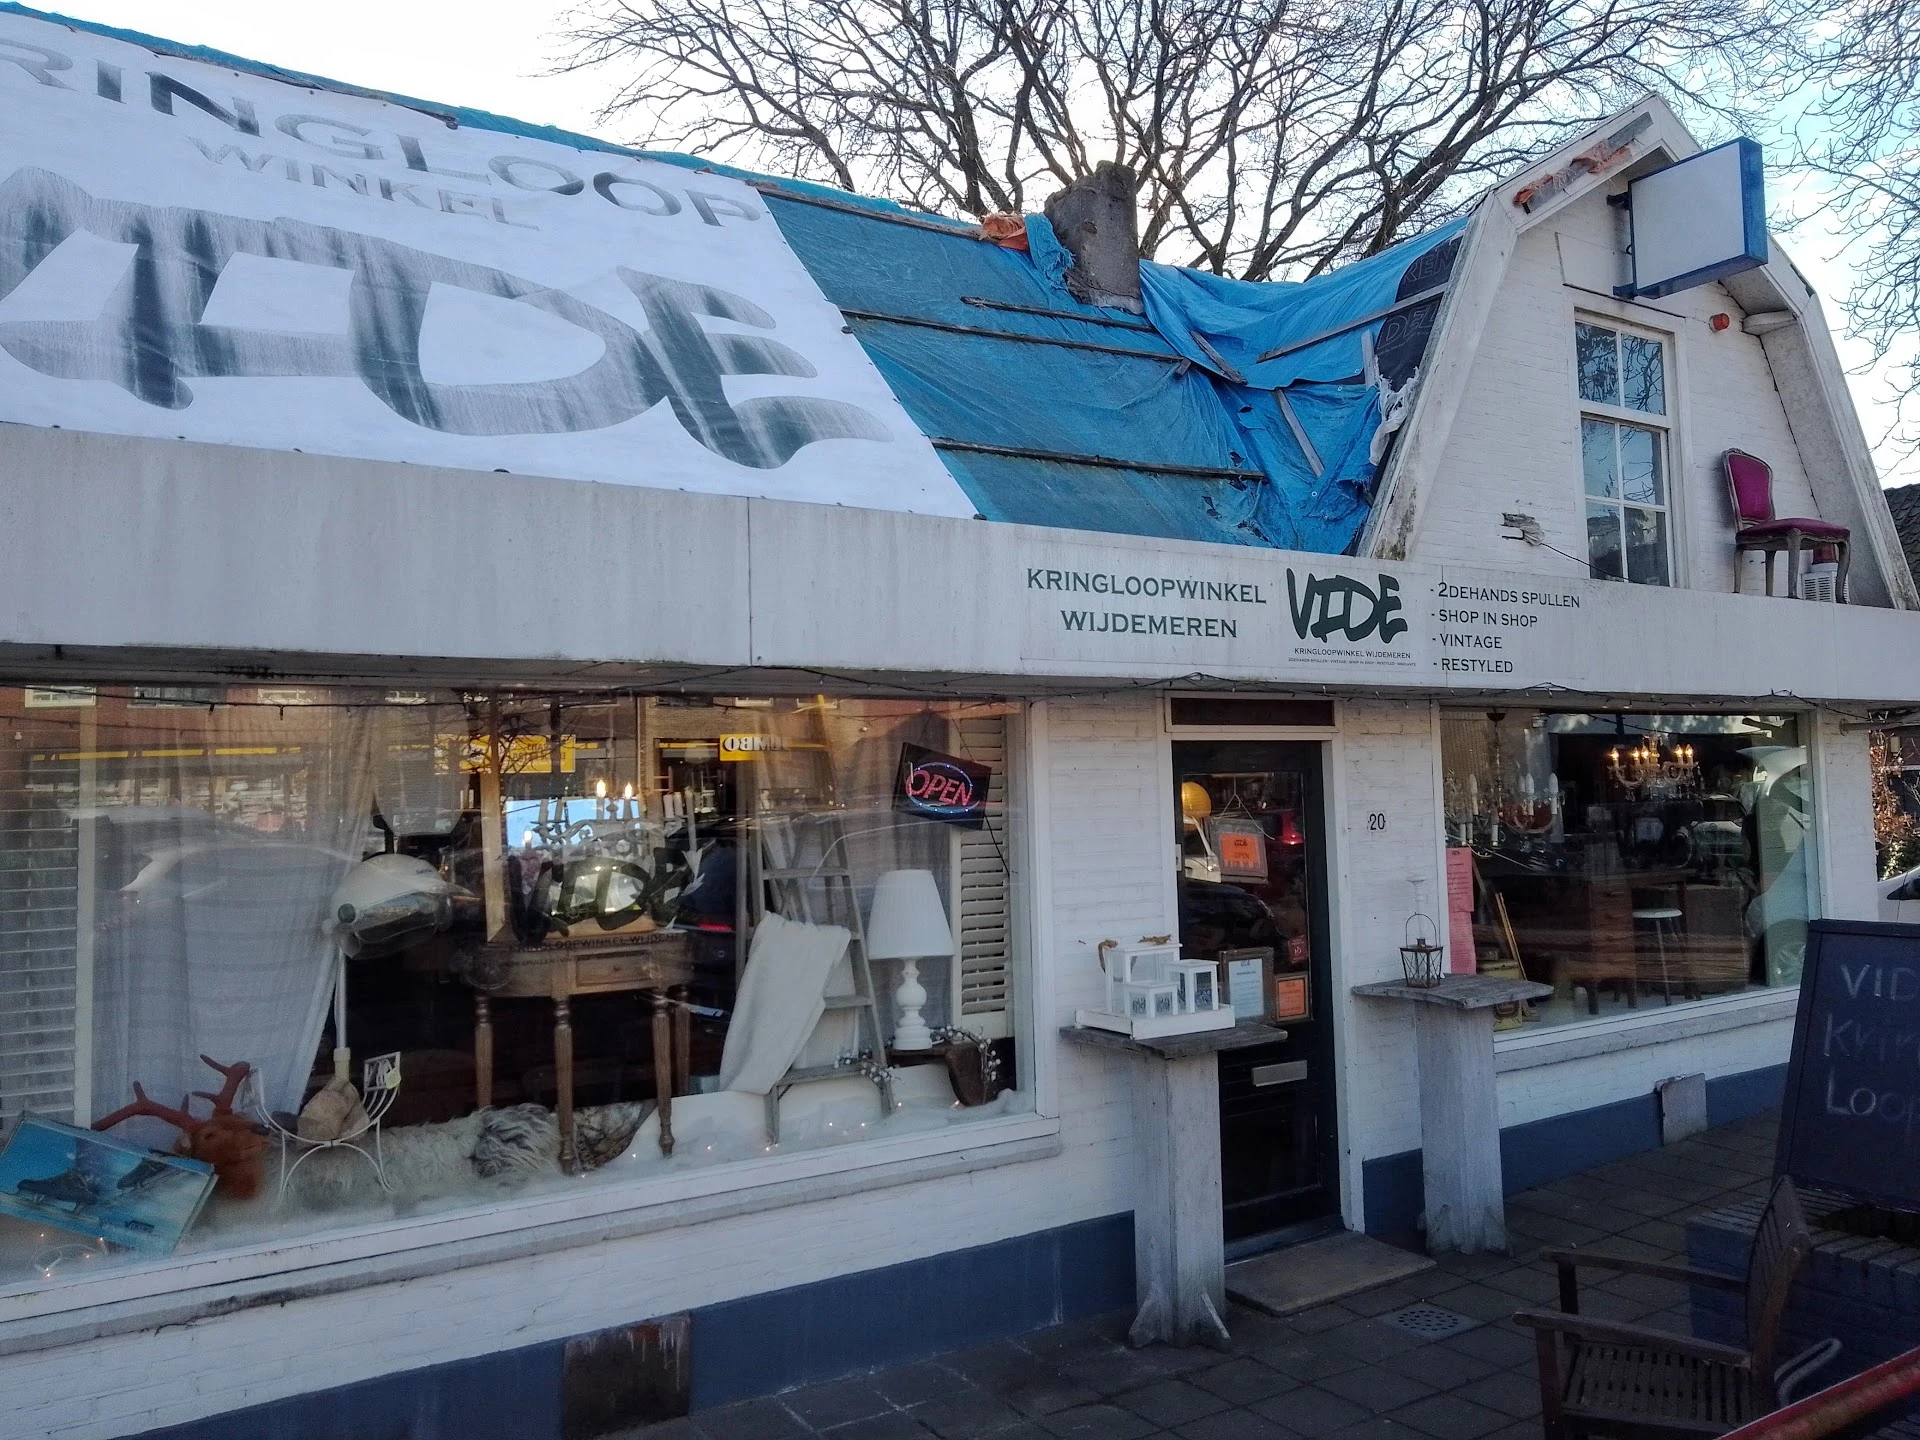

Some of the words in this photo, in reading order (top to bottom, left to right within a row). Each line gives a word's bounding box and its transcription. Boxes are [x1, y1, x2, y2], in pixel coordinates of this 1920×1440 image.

[185, 134, 540, 231] WINKEL
[1026, 567, 1267, 604] KRINGLOOPWINKEL
[1438, 581, 1518, 603] 2DEHANDS
[1522, 591, 1580, 608] SPULLEN
[1286, 567, 1409, 644] VIDE
[1439, 609, 1479, 624] SHOP
[1483, 612, 1497, 625] IN
[1501, 613, 1538, 627] SHOP
[1060, 609, 1238, 638] WIJDEMEREN
[1294, 647, 1364, 657] KRINGLOOPWINKEL
[1365, 651, 1411, 659] WIJDEMEREN
[1440, 633, 1503, 649] VINTAGE
[1441, 657, 1514, 673] RESTYLED
[906, 769, 973, 807] OPEN
[1369, 813, 1386, 831] 20
